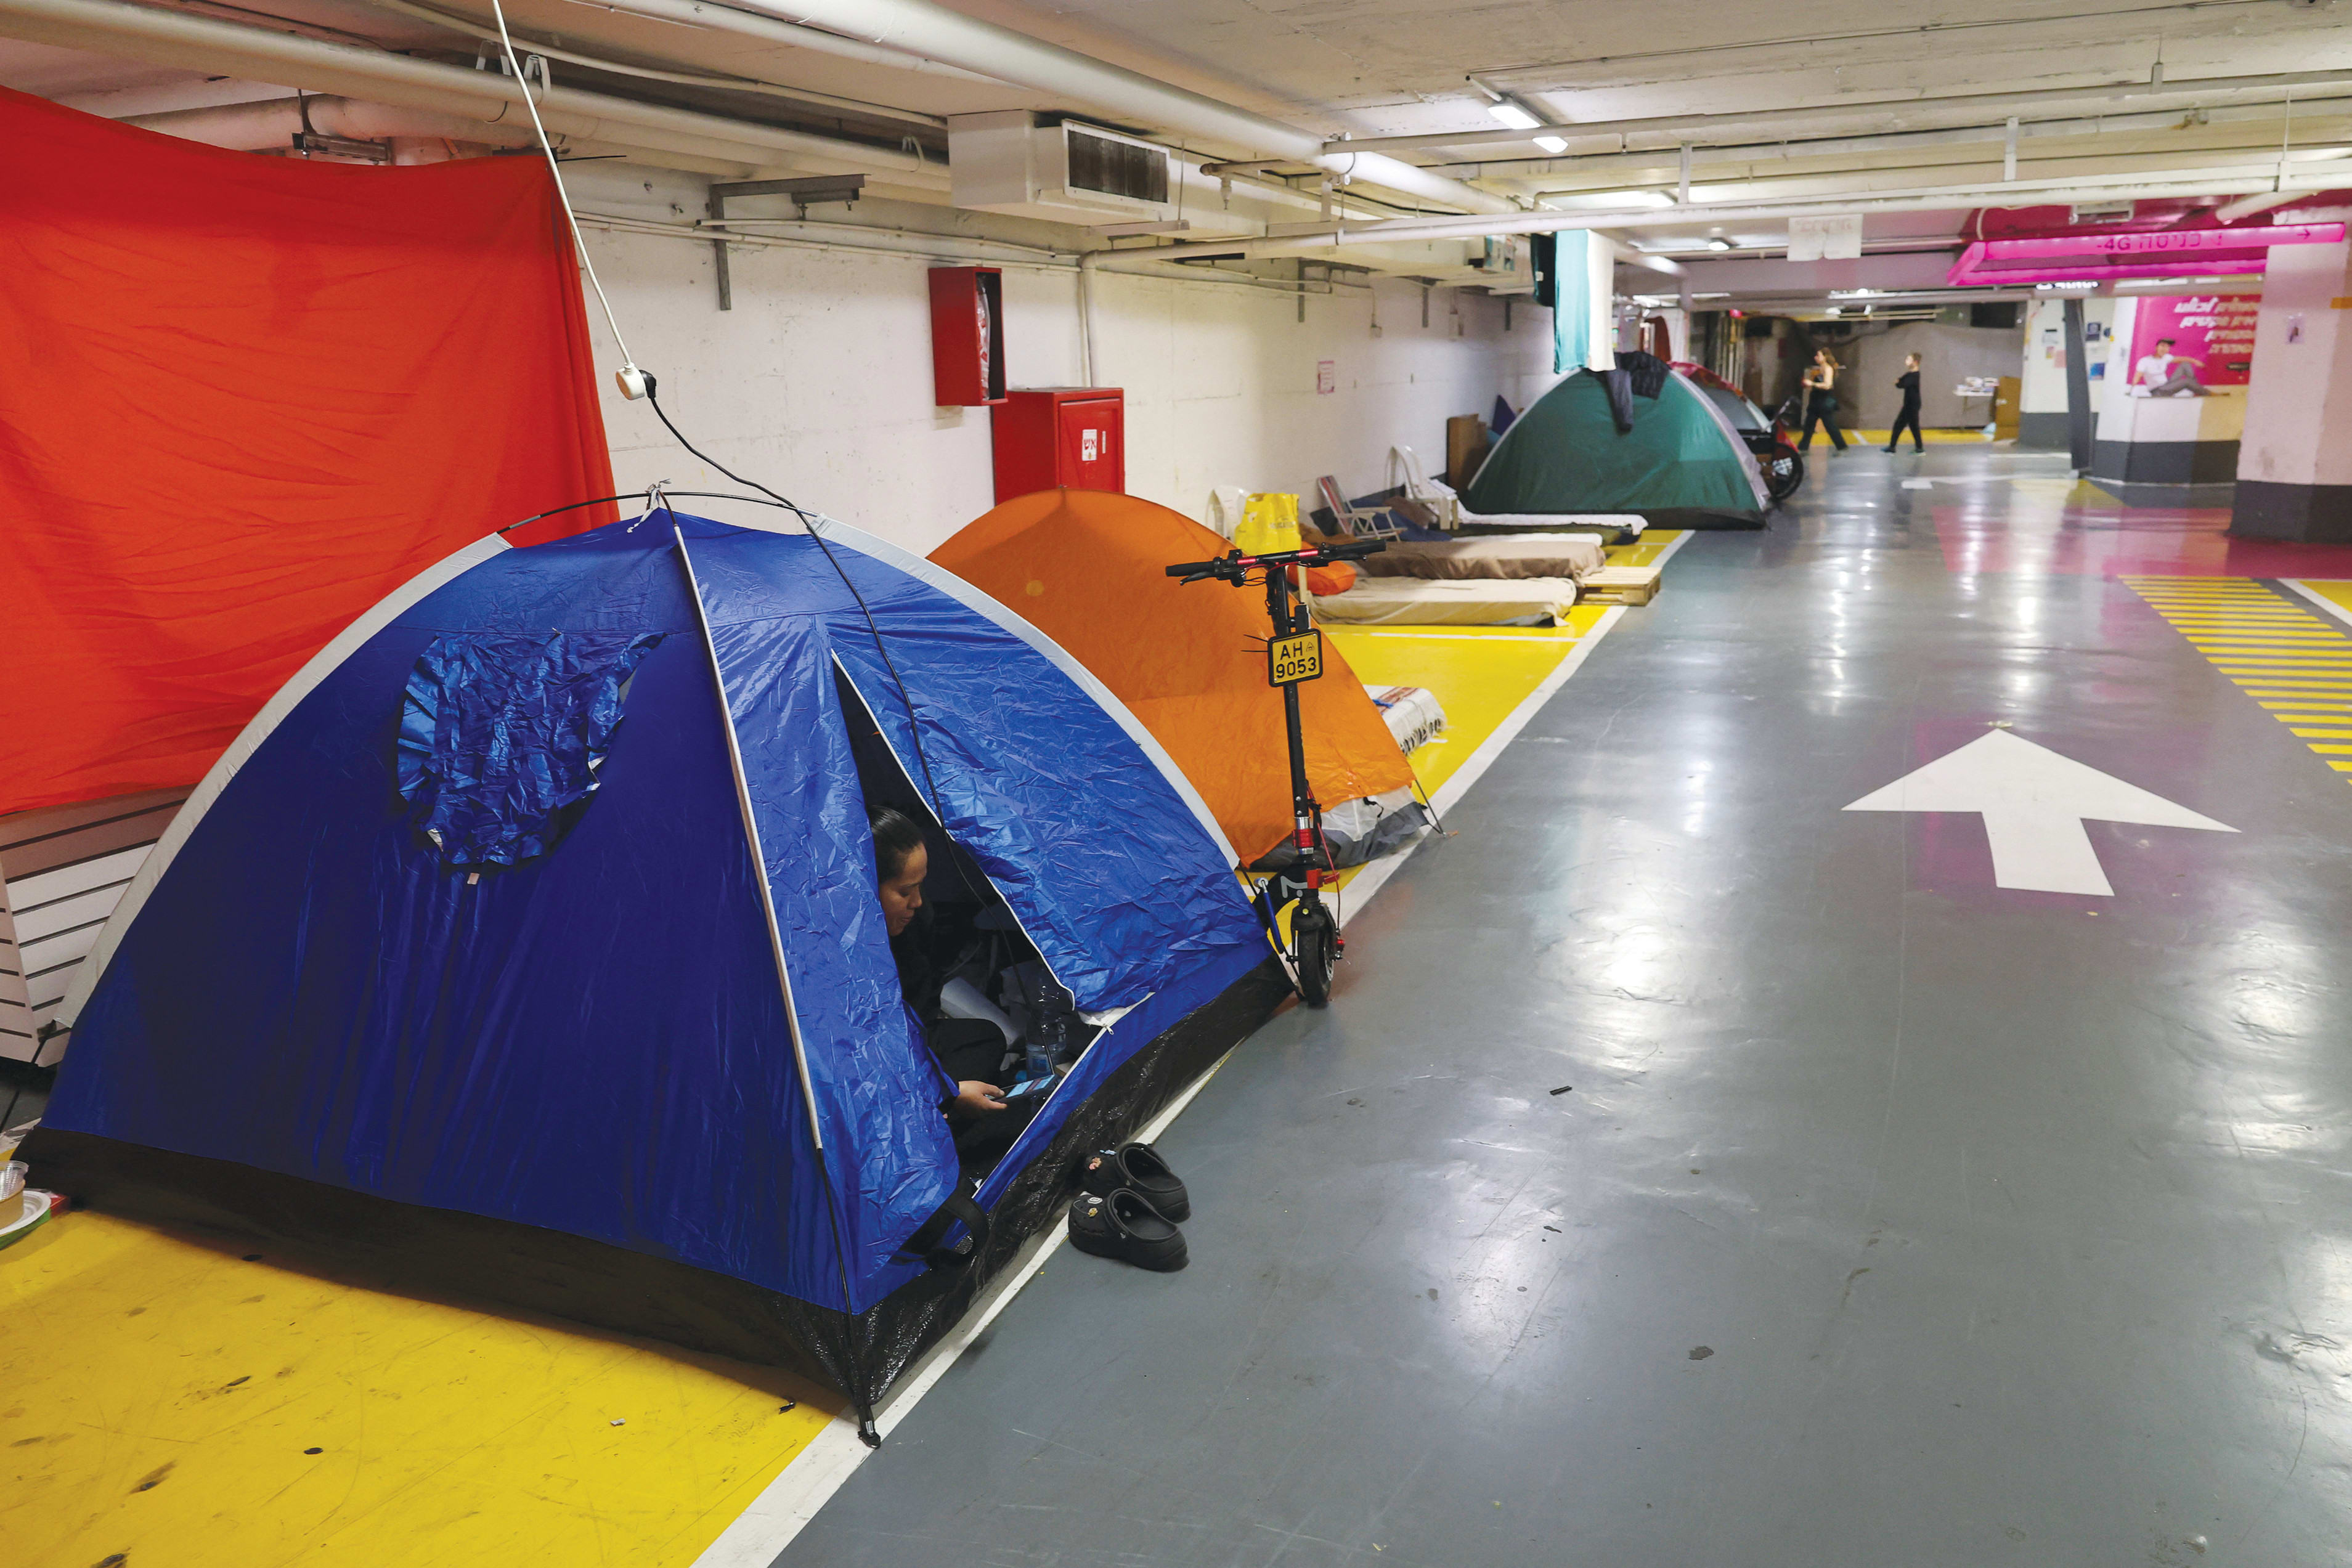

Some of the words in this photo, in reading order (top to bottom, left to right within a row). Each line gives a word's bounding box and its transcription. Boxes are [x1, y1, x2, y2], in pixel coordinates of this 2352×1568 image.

[1084, 439, 1096, 450] אש
[1280, 641, 1303, 660] AH
[1276, 656, 1316, 678] 9053
